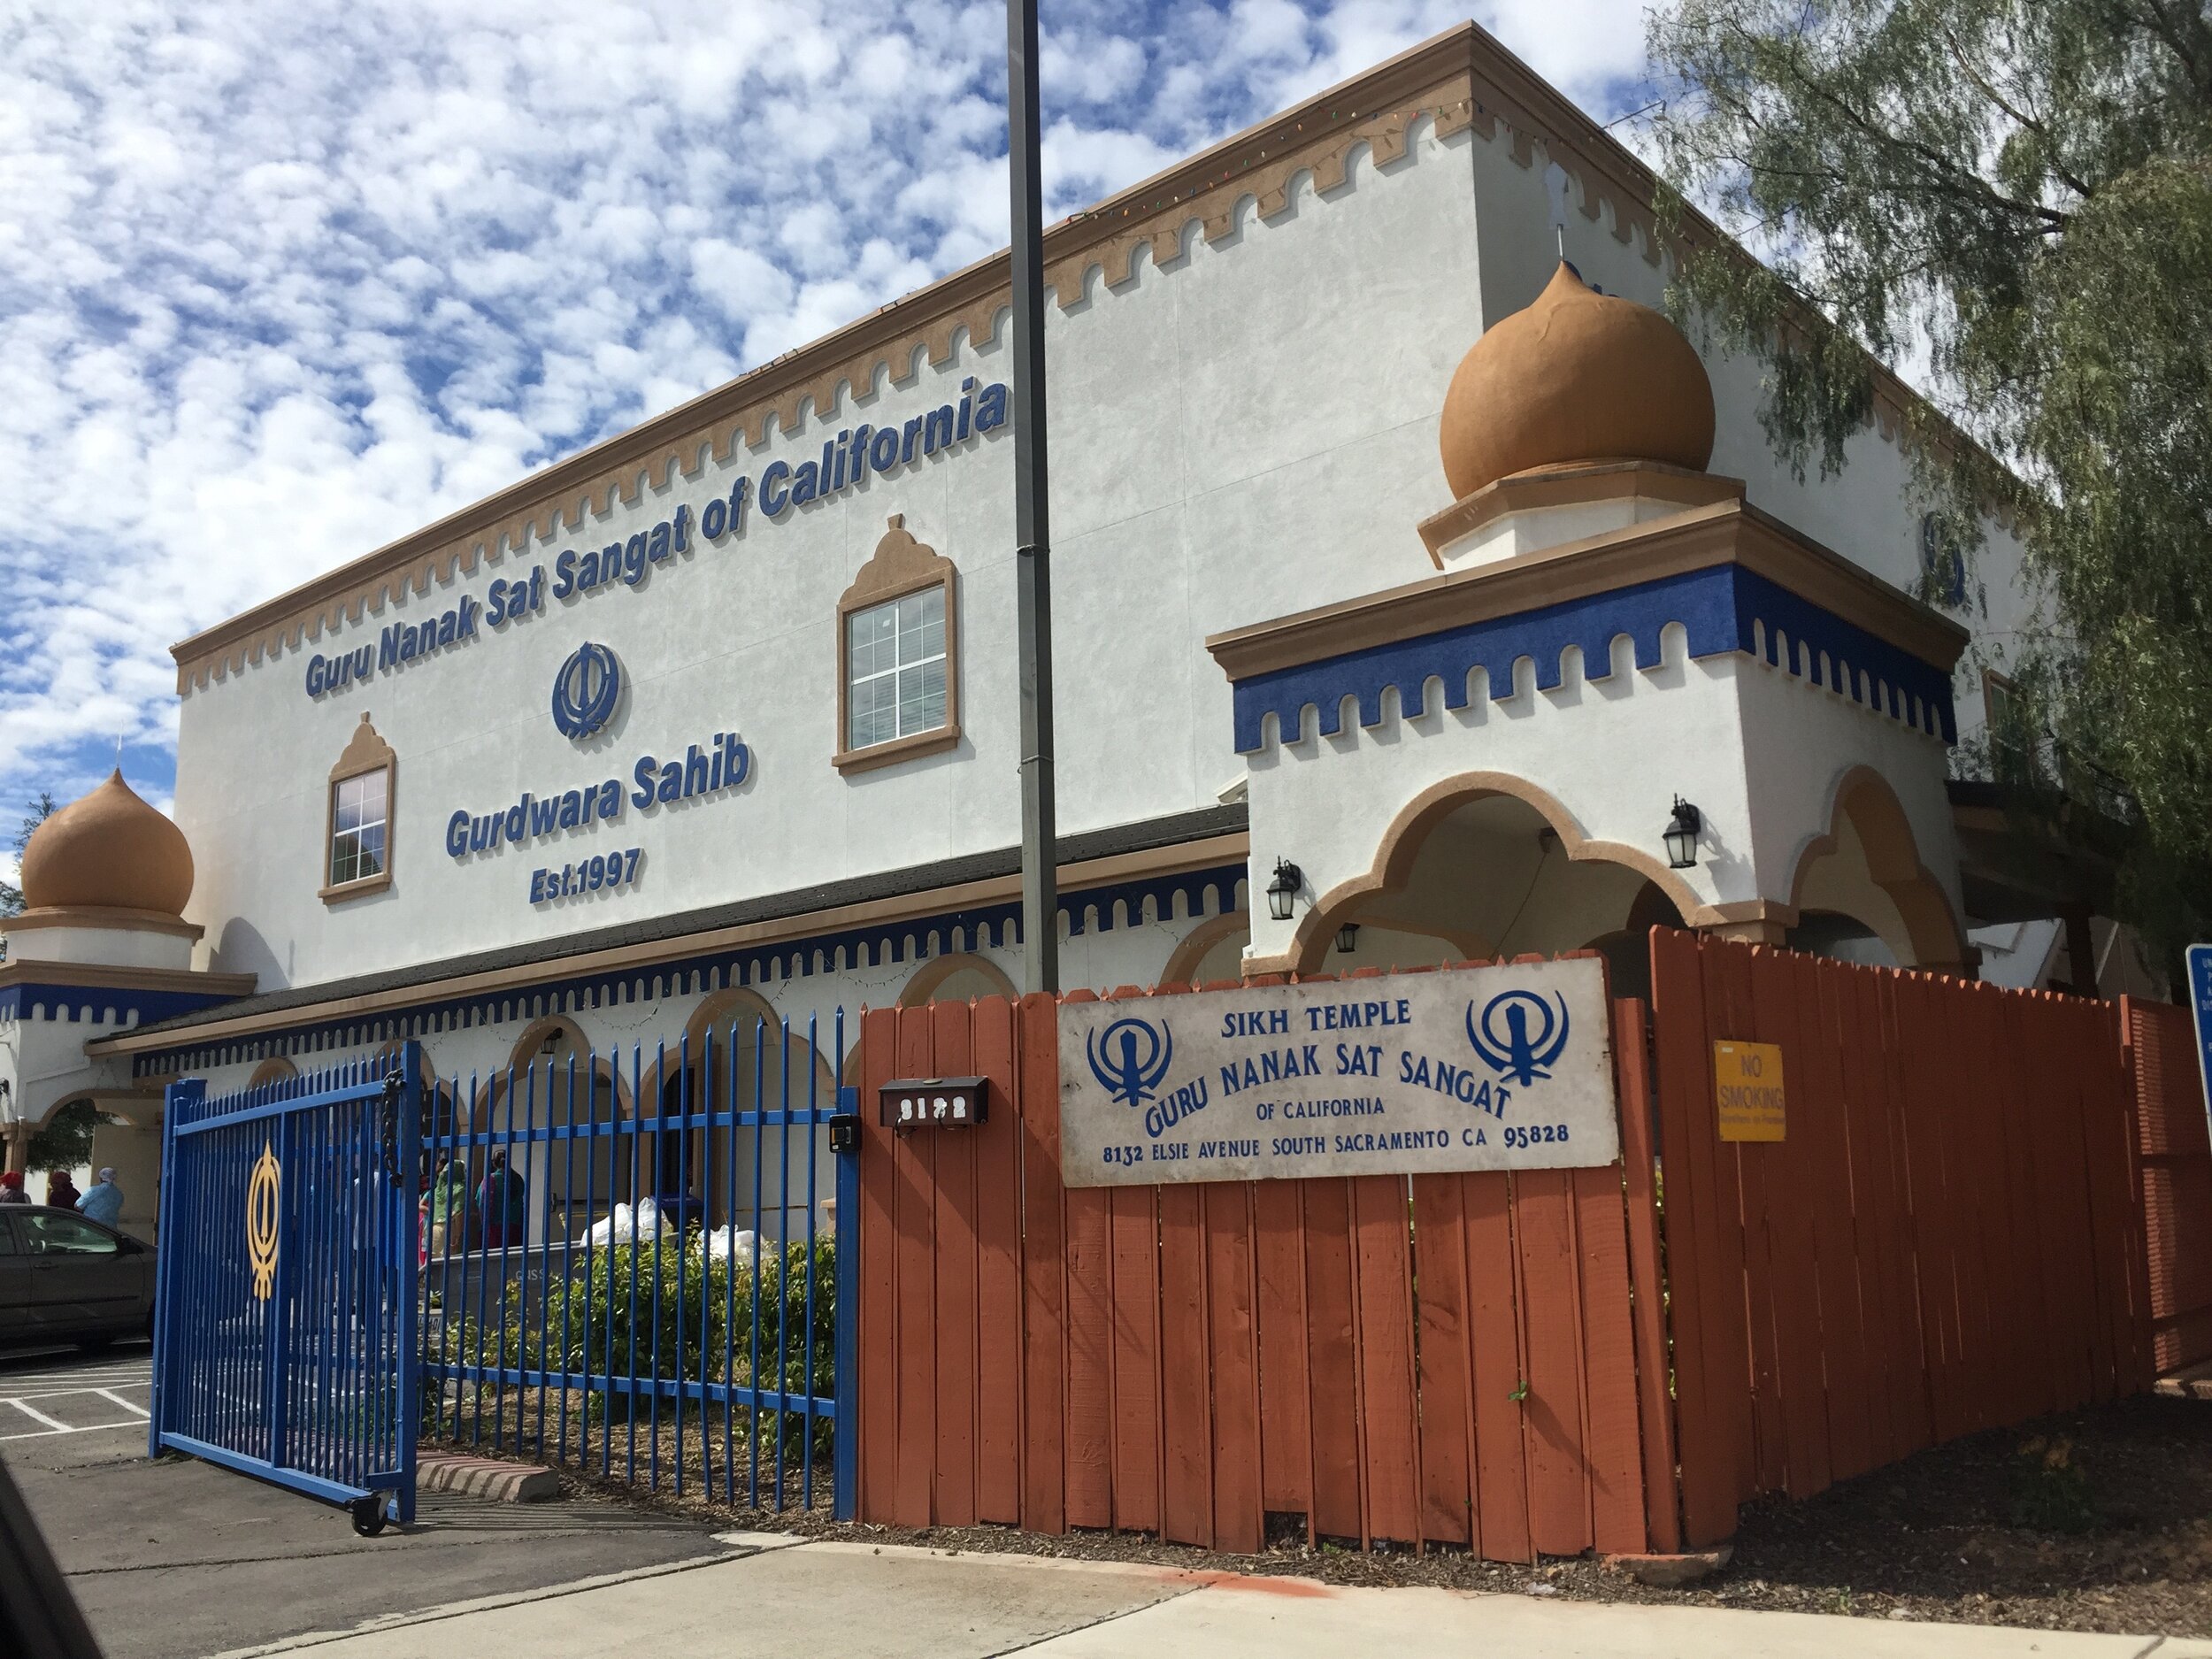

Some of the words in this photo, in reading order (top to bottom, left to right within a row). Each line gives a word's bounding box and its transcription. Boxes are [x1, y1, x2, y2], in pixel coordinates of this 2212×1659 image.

[305, 643, 372, 695] Guru
[379, 595, 479, 669] Nanak
[485, 566, 543, 626] Sat
[552, 503, 689, 601] Sangat
[702, 476, 748, 540] of
[758, 376, 1007, 517] California
[446, 779, 621, 857] Gurdwara
[631, 733, 749, 810] Sahib
[529, 848, 645, 903] Est.1997
[1221, 1009, 1289, 1038] SIKH
[1305, 999, 1412, 1032] TEMPLE
[1741, 1054, 1763, 1078] NO
[1145, 1076, 1209, 1138] GURU
[1220, 1045, 1322, 1096] NANAK
[1336, 1043, 1384, 1076] SAT
[1400, 1051, 1512, 1120] SANGAT
[1256, 1102, 1275, 1120] OF
[1283, 1097, 1385, 1119] CALIFORNIA
[1719, 1085, 1784, 1110] SMOKING
[1102, 1146, 1143, 1166] 8132
[1152, 1142, 1189, 1160] ELSIE
[1197, 1140, 1260, 1158] AVENUE
[1272, 1135, 1325, 1155] SOUTH
[1334, 1130, 1449, 1152] SACRAMENTO
[1462, 1127, 1487, 1147] CA
[1504, 1125, 1570, 1148] 95828
